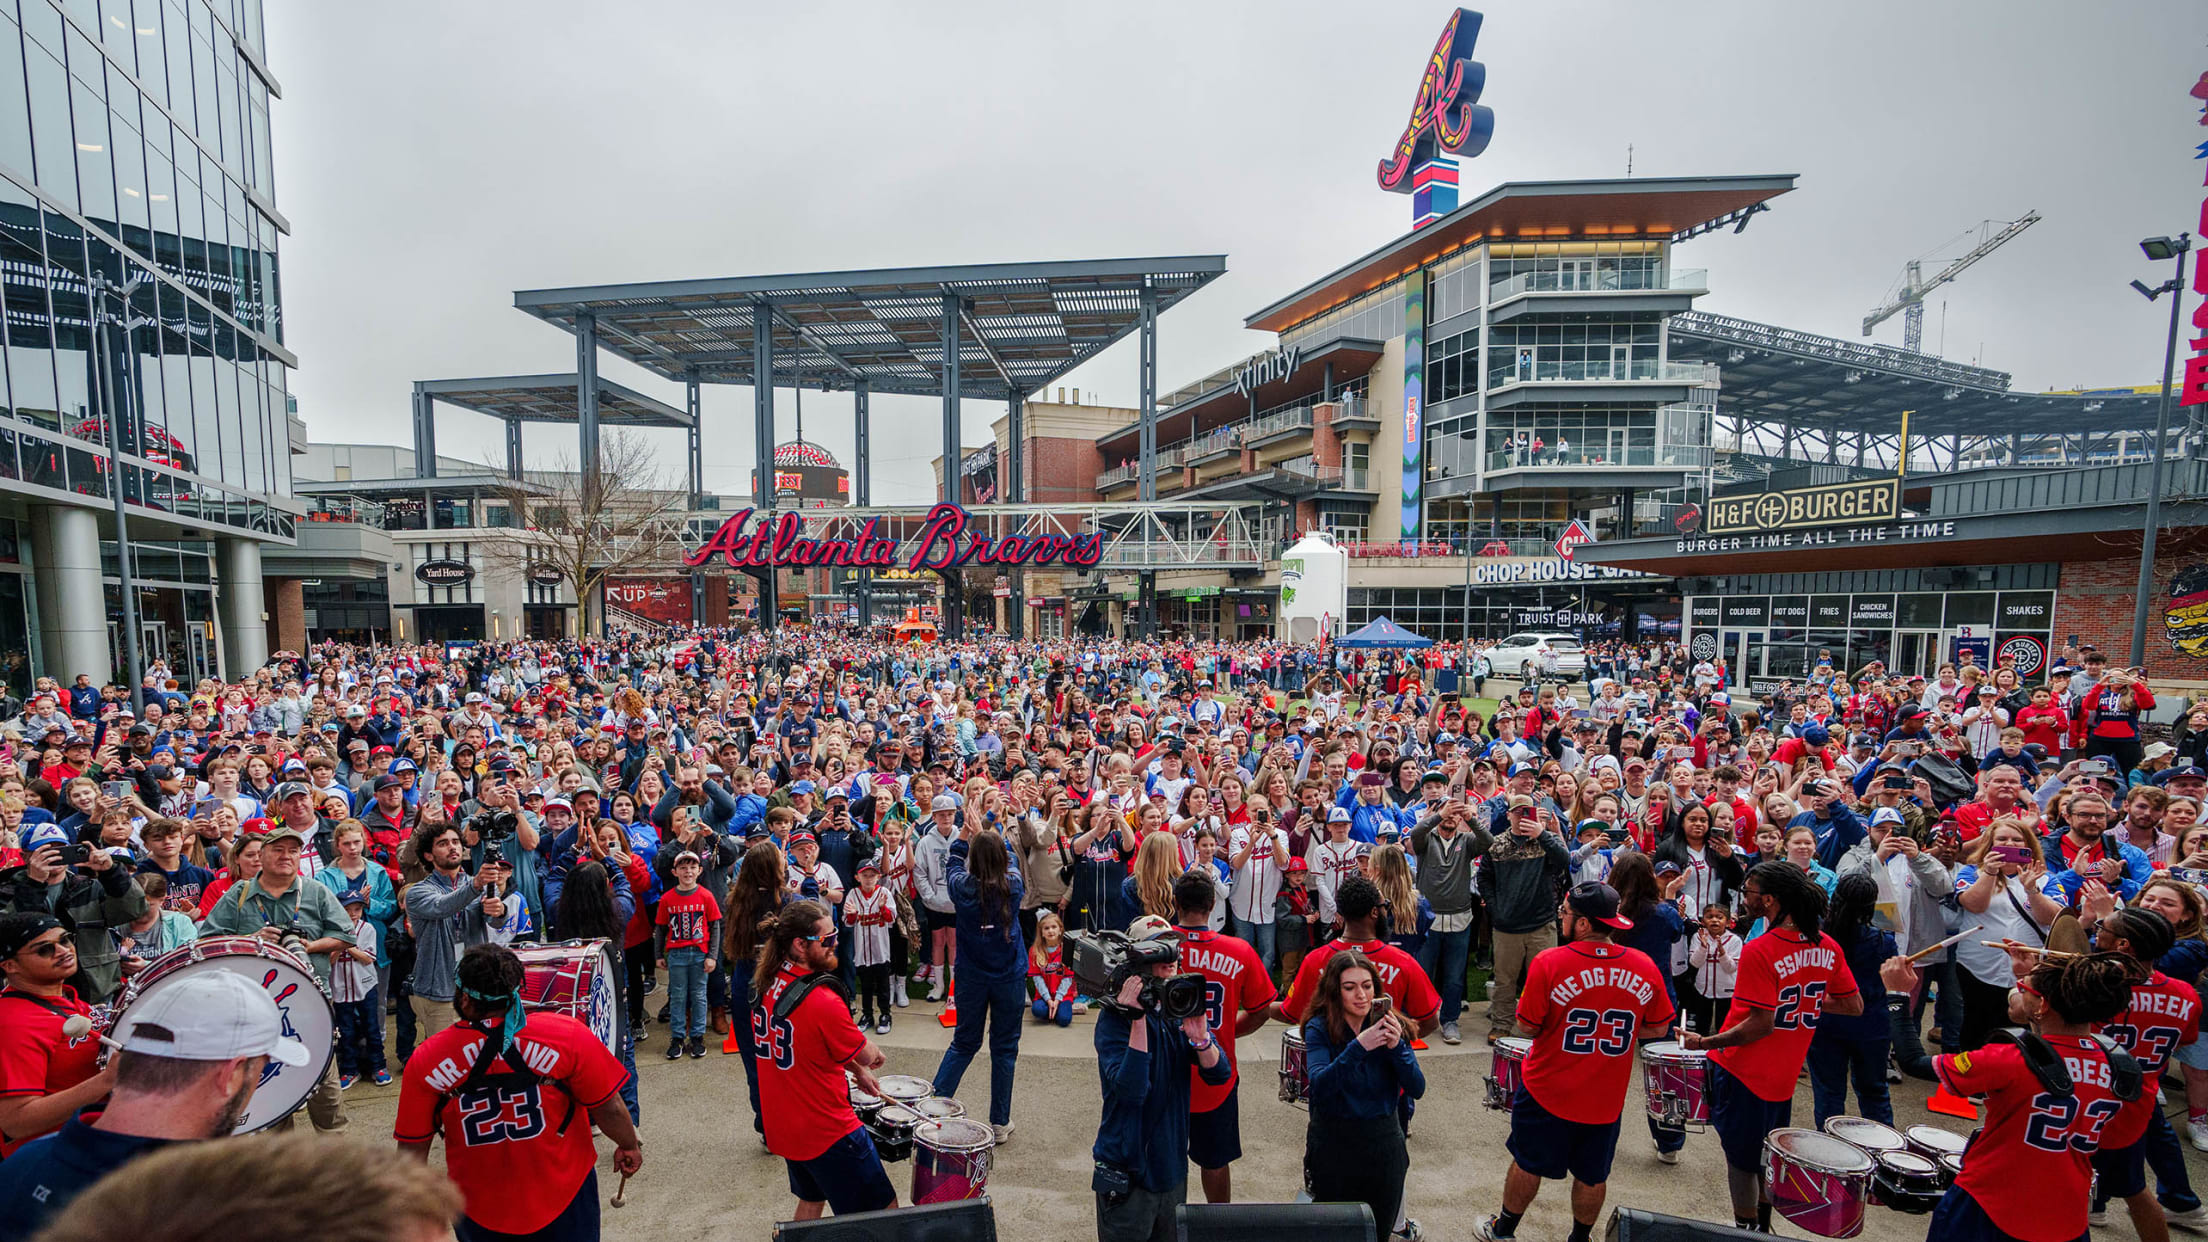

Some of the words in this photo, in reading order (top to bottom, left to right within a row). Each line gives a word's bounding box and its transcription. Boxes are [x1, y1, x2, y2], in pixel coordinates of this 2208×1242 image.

[1234, 346, 1299, 399] xfinity
[779, 475, 800, 489] FEST
[1676, 509, 1698, 526] OPEN
[1713, 501, 1754, 527] H&F
[1789, 487, 1890, 521] BURGER
[683, 506, 900, 568] Atlanta
[908, 501, 1106, 573] Braves
[1676, 537, 1741, 553] BURGER
[1750, 534, 1792, 549] TIME
[1802, 531, 1837, 546] ALL
[1848, 527, 1887, 542] THE
[1899, 522, 1955, 539] TIME
[425, 568, 442, 578] Yard
[443, 568, 465, 577] House
[1475, 563, 1524, 583] CHOP
[1529, 560, 1596, 582] HOUSE
[1602, 565, 1659, 578] GA
[623, 589, 646, 602] UP
[1693, 608, 1718, 616] BURGERS
[1729, 608, 1744, 616] COLD
[1746, 607, 1761, 615] BEER
[1774, 607, 1787, 616] HOT
[1787, 607, 1806, 616] DOGS
[1819, 607, 1840, 616] FRIES
[2006, 605, 2044, 616] SHAKES
[1859, 603, 1887, 611] CHICKEN
[1518, 612, 1555, 625] TRUIST
[1573, 612, 1604, 625] PARK
[1852, 611, 1894, 620] SANDWICHES
[1189, 947, 1244, 980] DADDY
[1774, 947, 1836, 980] SSMOOVE
[1550, 975, 1583, 1006] THE
[1580, 967, 1605, 989] OG
[1609, 967, 1654, 1006] FUEGO
[1773, 980, 1828, 1031] 23
[752, 1005, 795, 1071] 23
[1562, 1007, 1636, 1057] 23
[2100, 1023, 2182, 1074] 23
[425, 1057, 468, 1092] MR.
[459, 1085, 546, 1147] 23
[2024, 1091, 2123, 1154] 23
